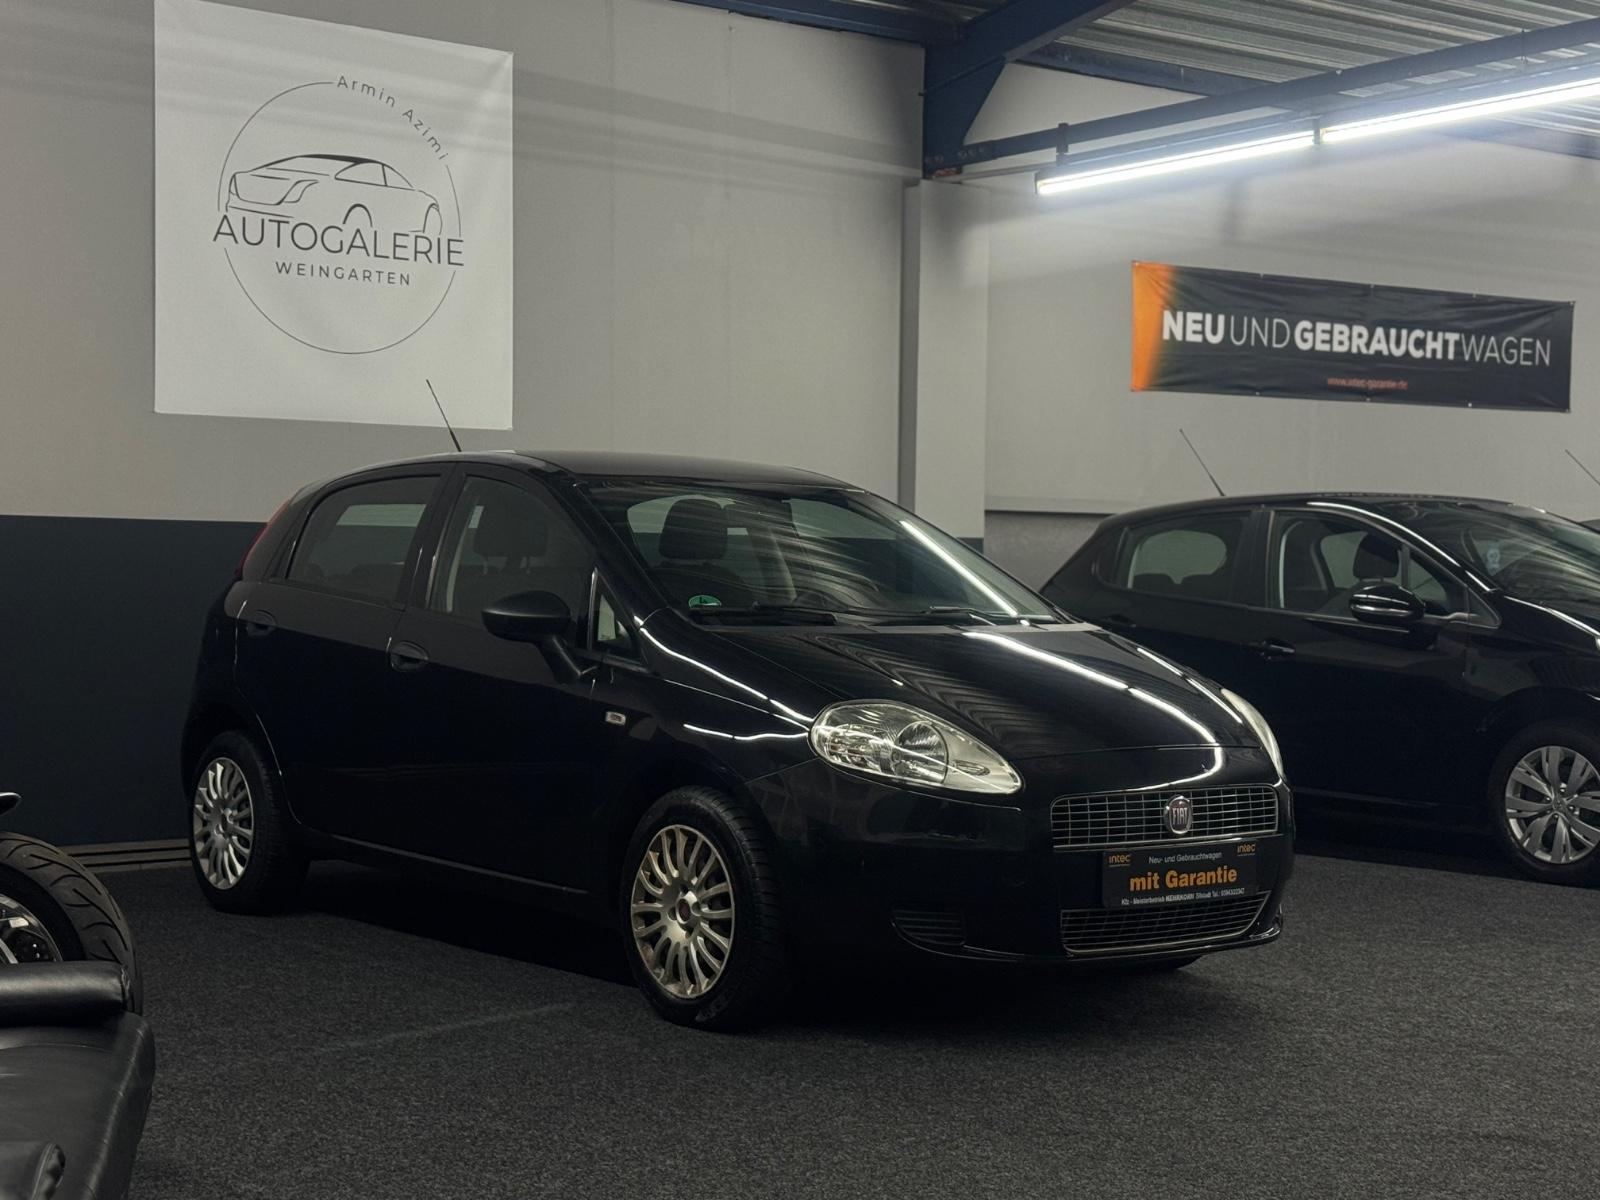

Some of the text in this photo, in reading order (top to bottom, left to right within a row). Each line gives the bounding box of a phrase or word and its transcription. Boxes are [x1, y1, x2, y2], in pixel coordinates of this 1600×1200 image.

[336, 75, 449, 160] Armin Azimi
[213, 214, 465, 267] AUTOGALERIE
[275, 261, 411, 286] WEINGARTEN
[1162, 309, 1225, 345] NEU
[1230, 315, 1291, 348] UND
[1172, 807, 1188, 825] FIAT
[1108, 853, 1131, 864] intec
[1164, 855, 1175, 863] und
[1176, 852, 1222, 863] Gebrauchtwagen
[1237, 843, 1256, 853] intec
[1129, 865, 1238, 892] mit Garantie
